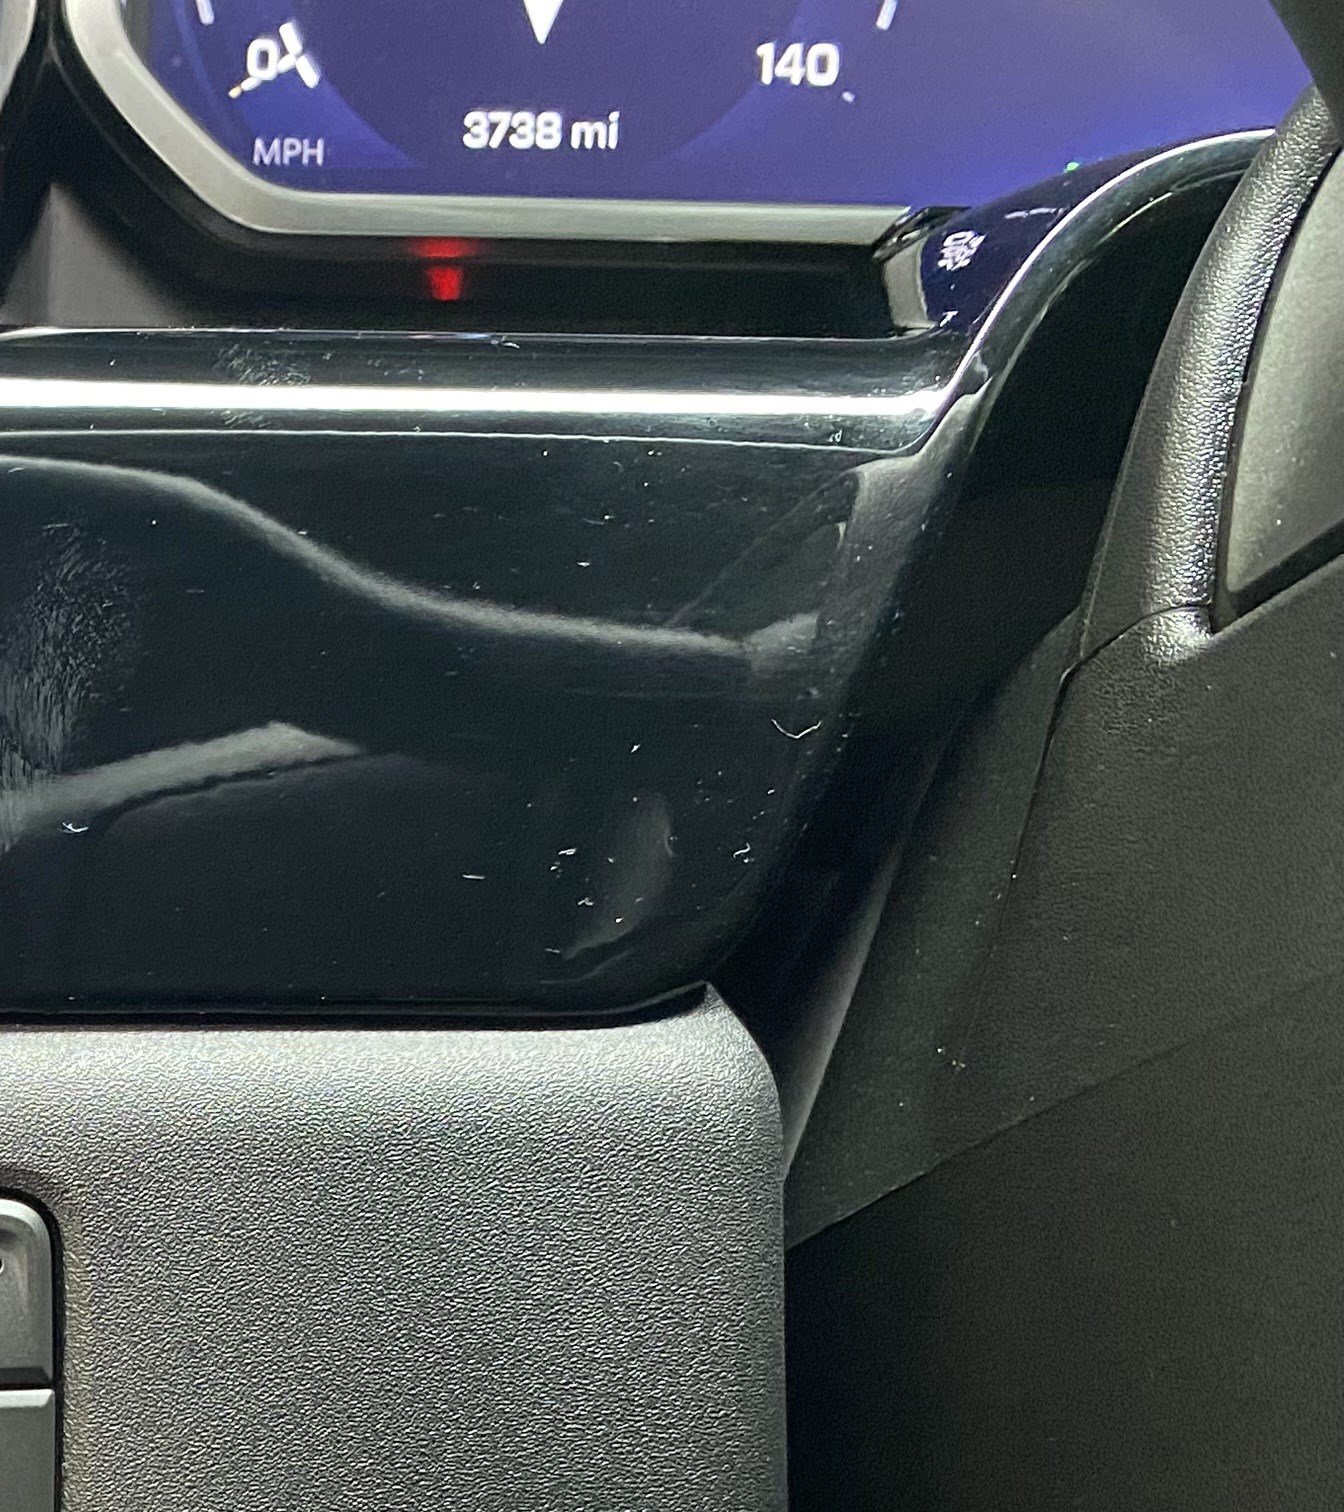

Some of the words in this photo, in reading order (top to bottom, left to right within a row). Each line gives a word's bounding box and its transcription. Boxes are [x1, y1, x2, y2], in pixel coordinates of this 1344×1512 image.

[756, 42, 840, 87] 140
[462, 110, 562, 150] 3738
[570, 110, 620, 150] mi
[252, 136, 325, 167] MPH
